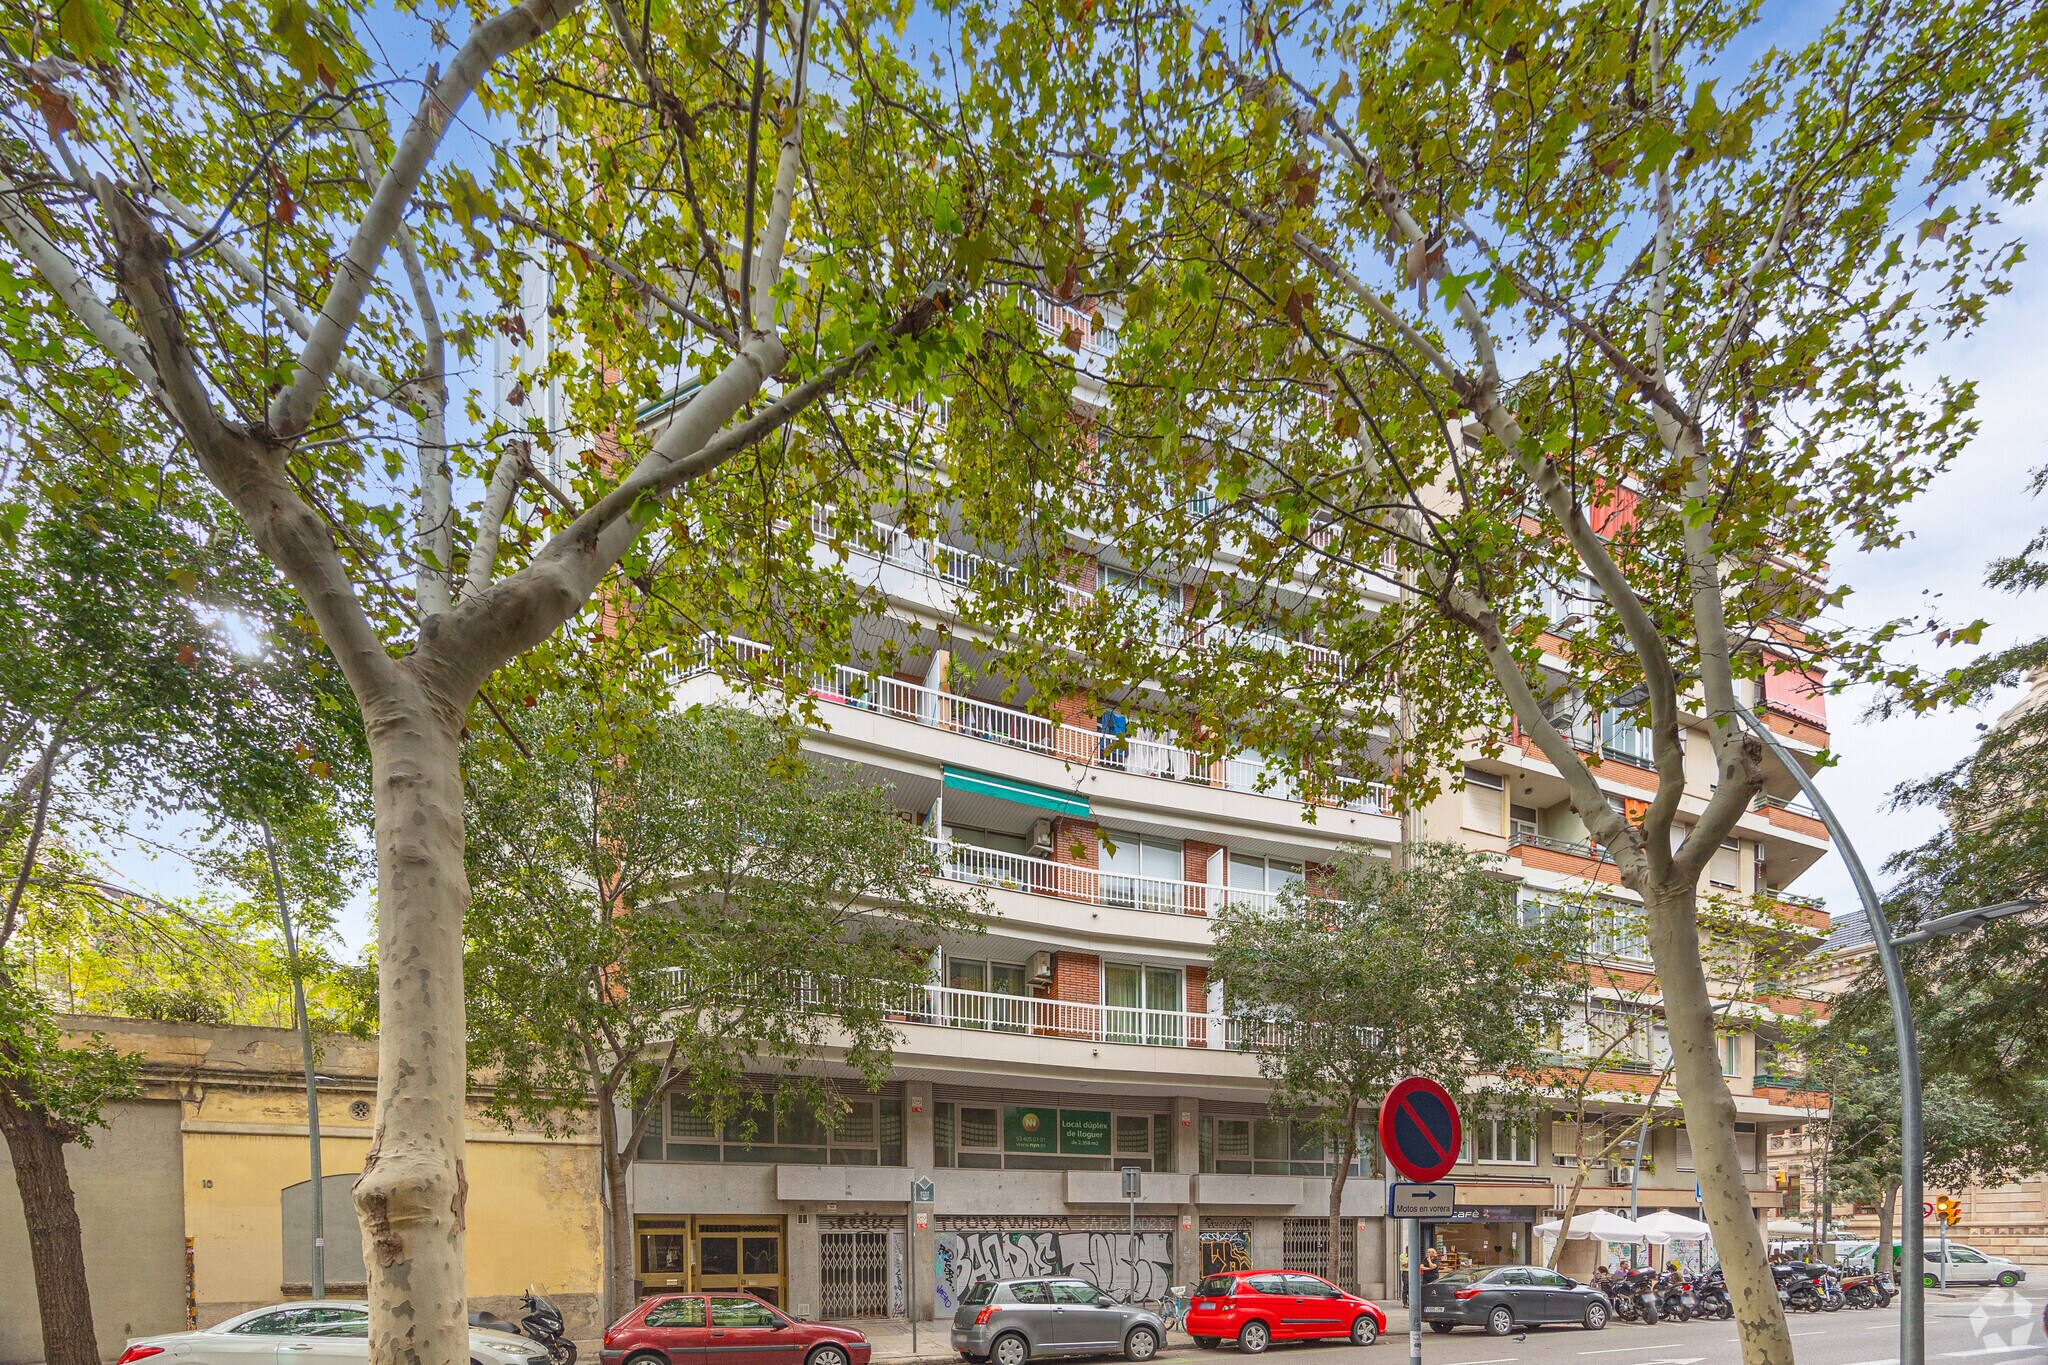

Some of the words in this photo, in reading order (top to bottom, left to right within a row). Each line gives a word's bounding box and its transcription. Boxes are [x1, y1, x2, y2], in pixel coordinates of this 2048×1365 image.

[1083, 1121, 1108, 1130] dúplex
[1077, 1130, 1103, 1140] lloguer
[1396, 1204, 1418, 1213] Motos
[1419, 1205, 1428, 1213] en
[1429, 1205, 1450, 1213] vorera
